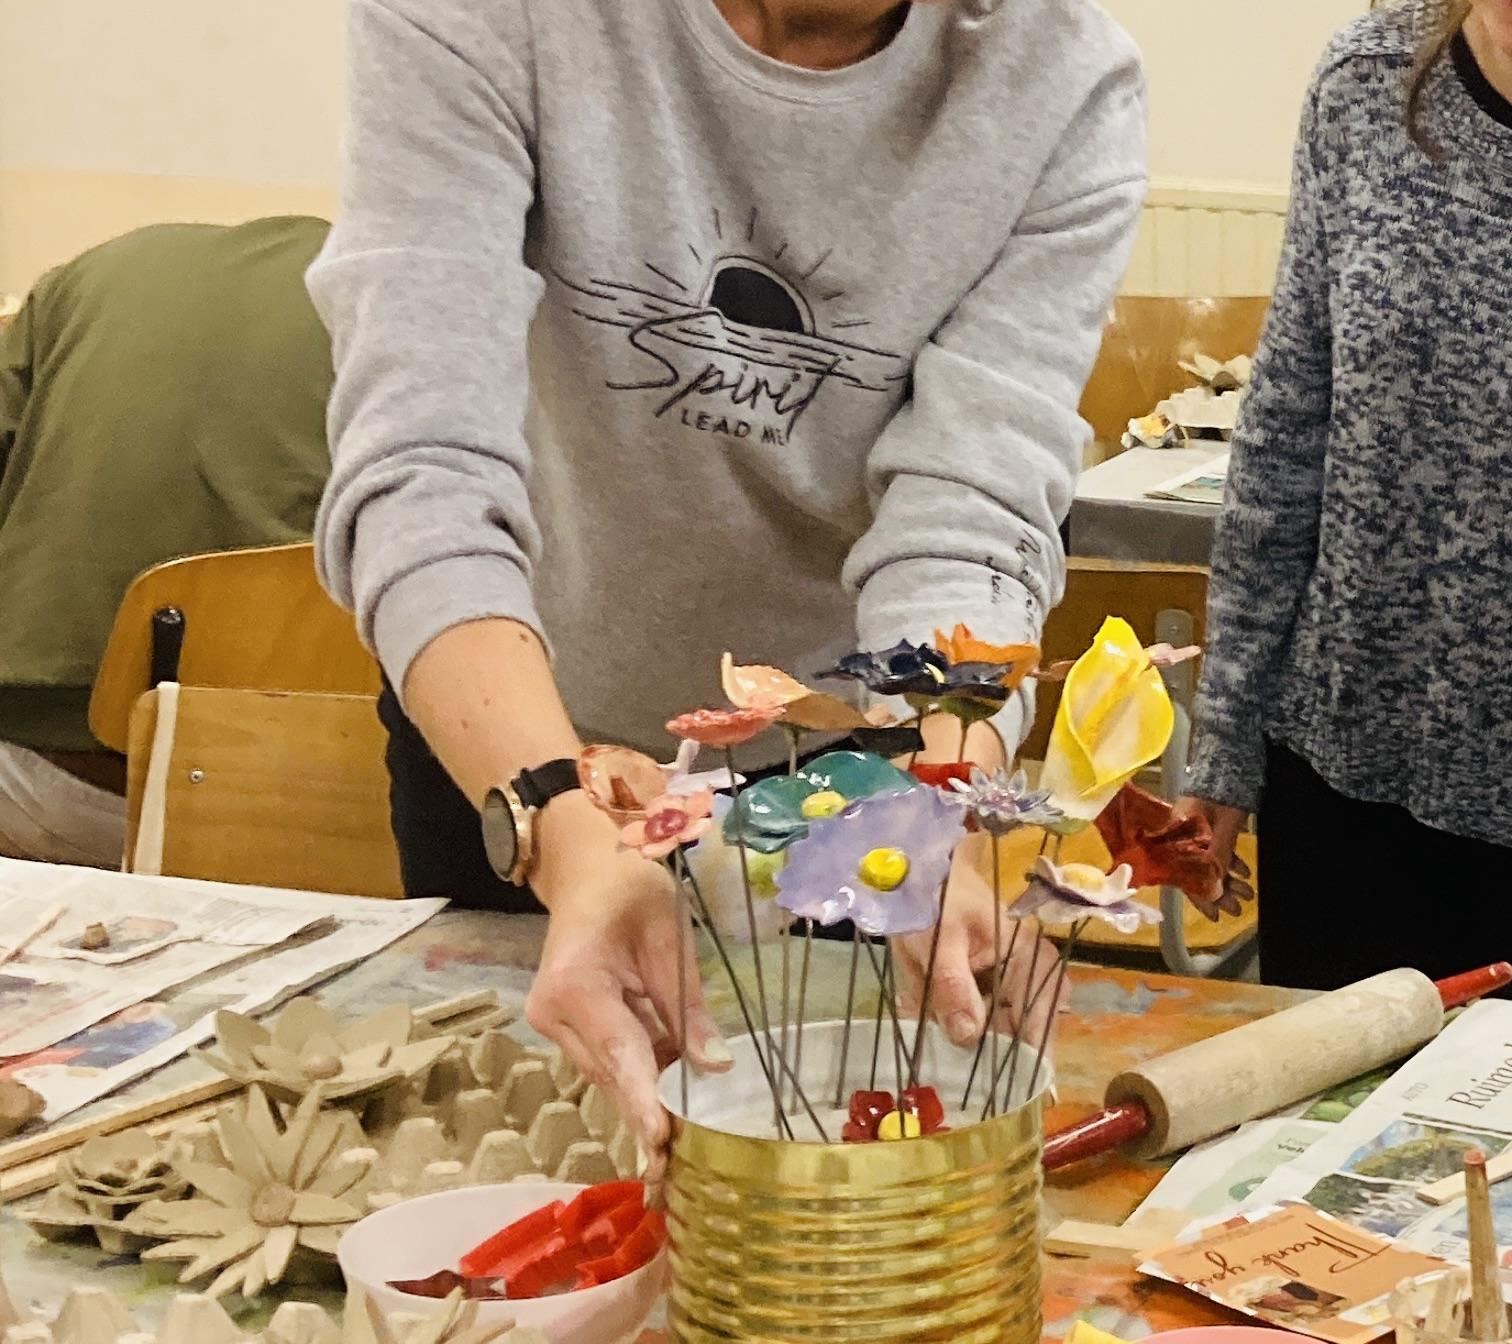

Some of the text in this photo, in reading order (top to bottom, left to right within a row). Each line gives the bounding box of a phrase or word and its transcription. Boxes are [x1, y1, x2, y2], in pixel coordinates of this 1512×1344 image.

[605, 309, 842, 442] Spirit
[681, 408, 752, 438] LEAD
[1189, 1249, 1247, 1289] you
[1252, 1222, 1393, 1277] Thank
